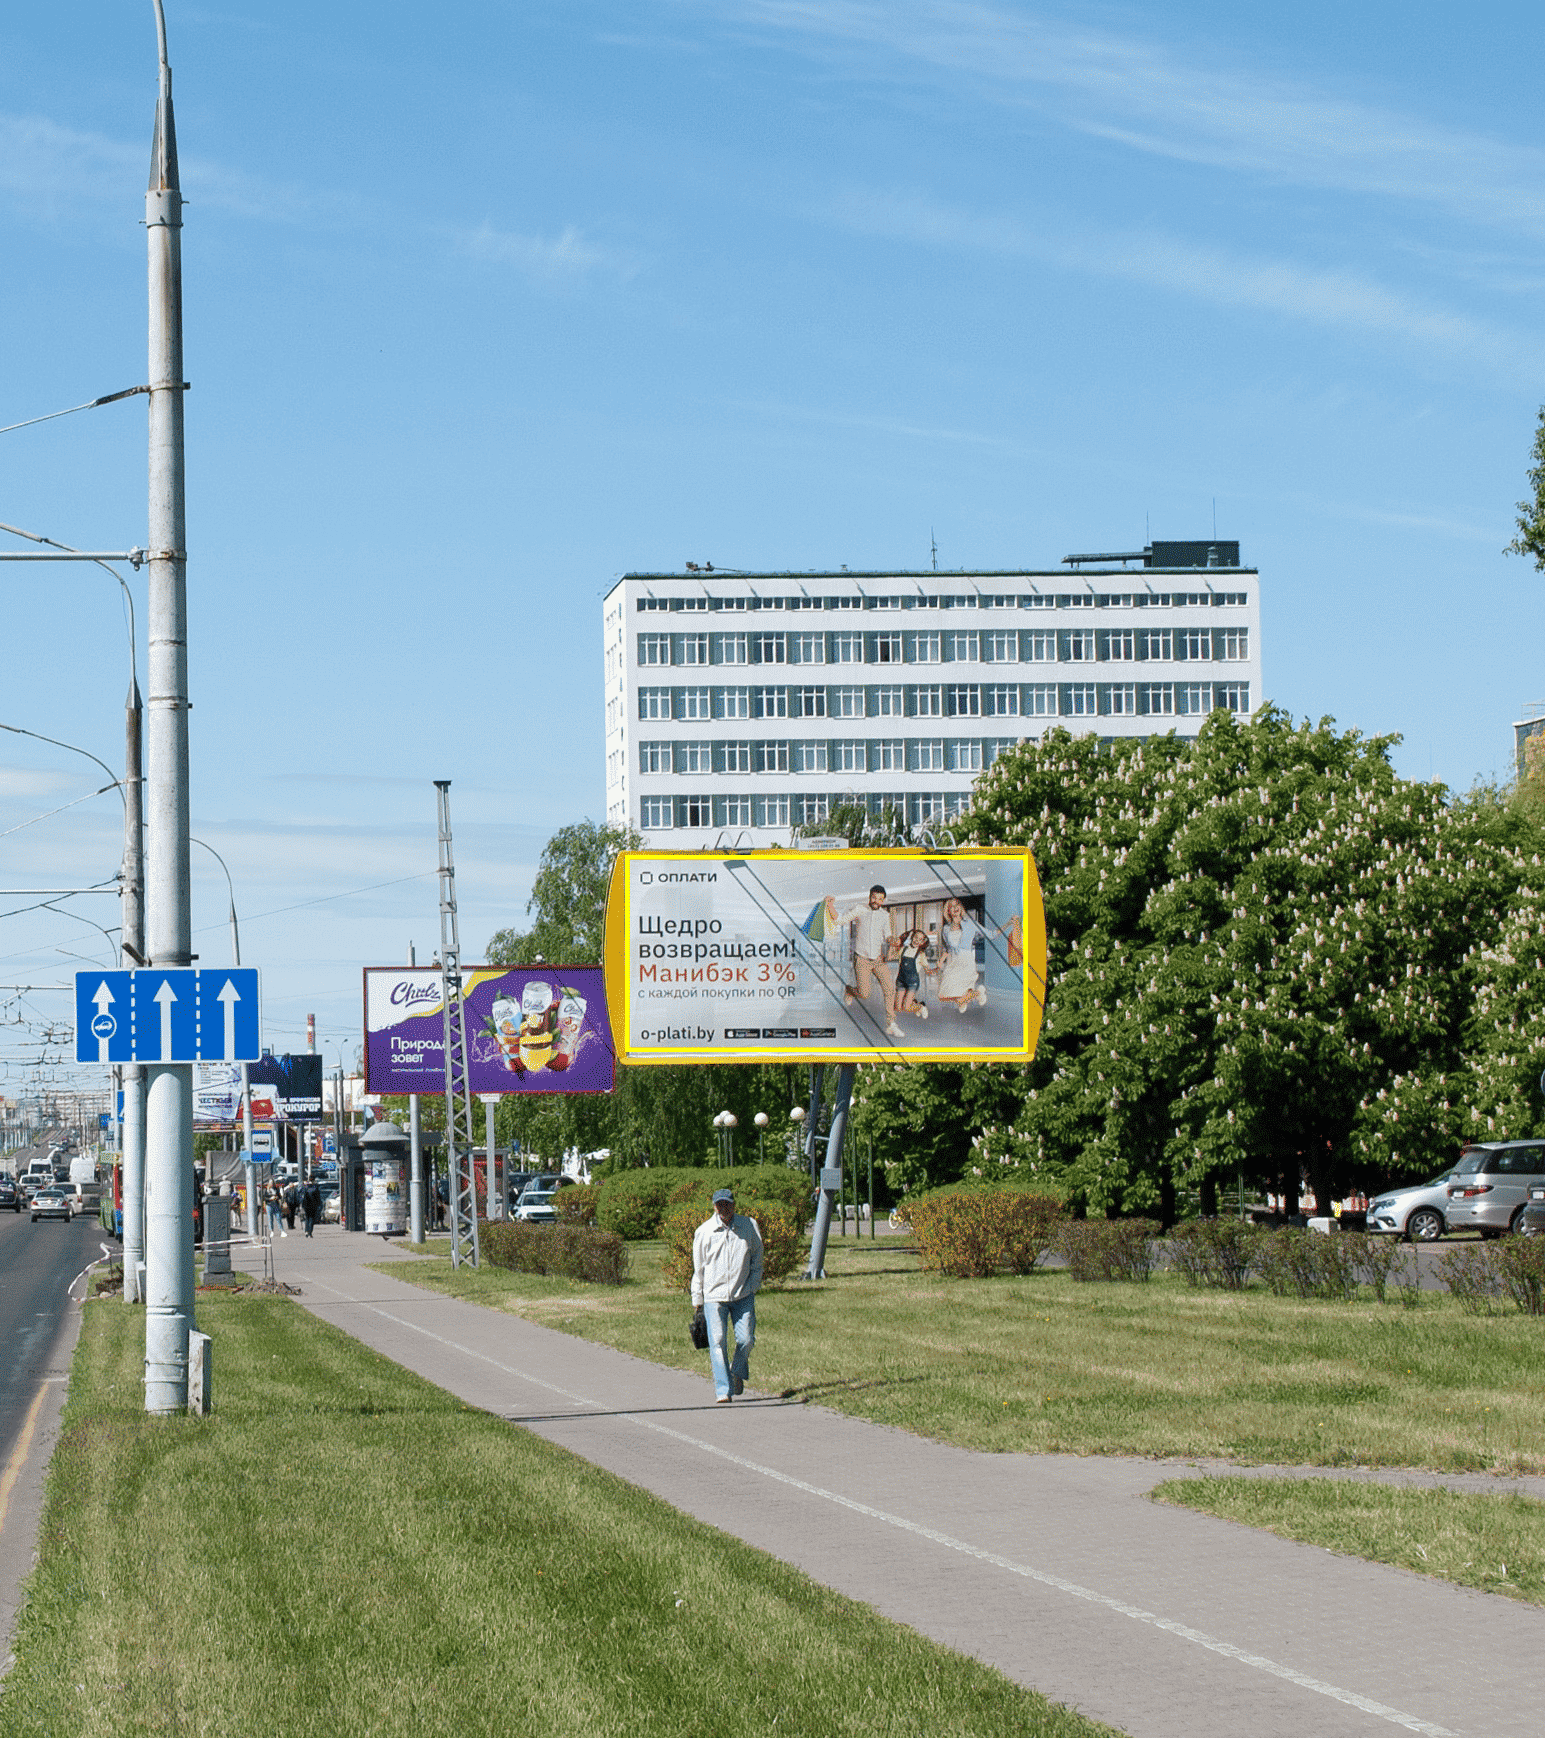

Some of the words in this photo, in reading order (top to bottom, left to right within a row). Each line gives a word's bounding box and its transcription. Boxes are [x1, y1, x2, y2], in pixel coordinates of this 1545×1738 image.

[658, 873, 717, 883] ОПЛАТИ
[639, 916, 723, 938] Щедро
[639, 939, 796, 962] возвращаем!
[639, 963, 749, 983] Манибэк
[757, 963, 796, 983] 3%
[637, 989, 645, 998] с
[648, 986, 698, 999] каждой
[701, 988, 755, 1000] покупки
[758, 988, 774, 998] по
[777, 986, 796, 999] QR
[641, 1025, 715, 1042] o-plati.by
[391, 1053, 424, 1063] зовет
